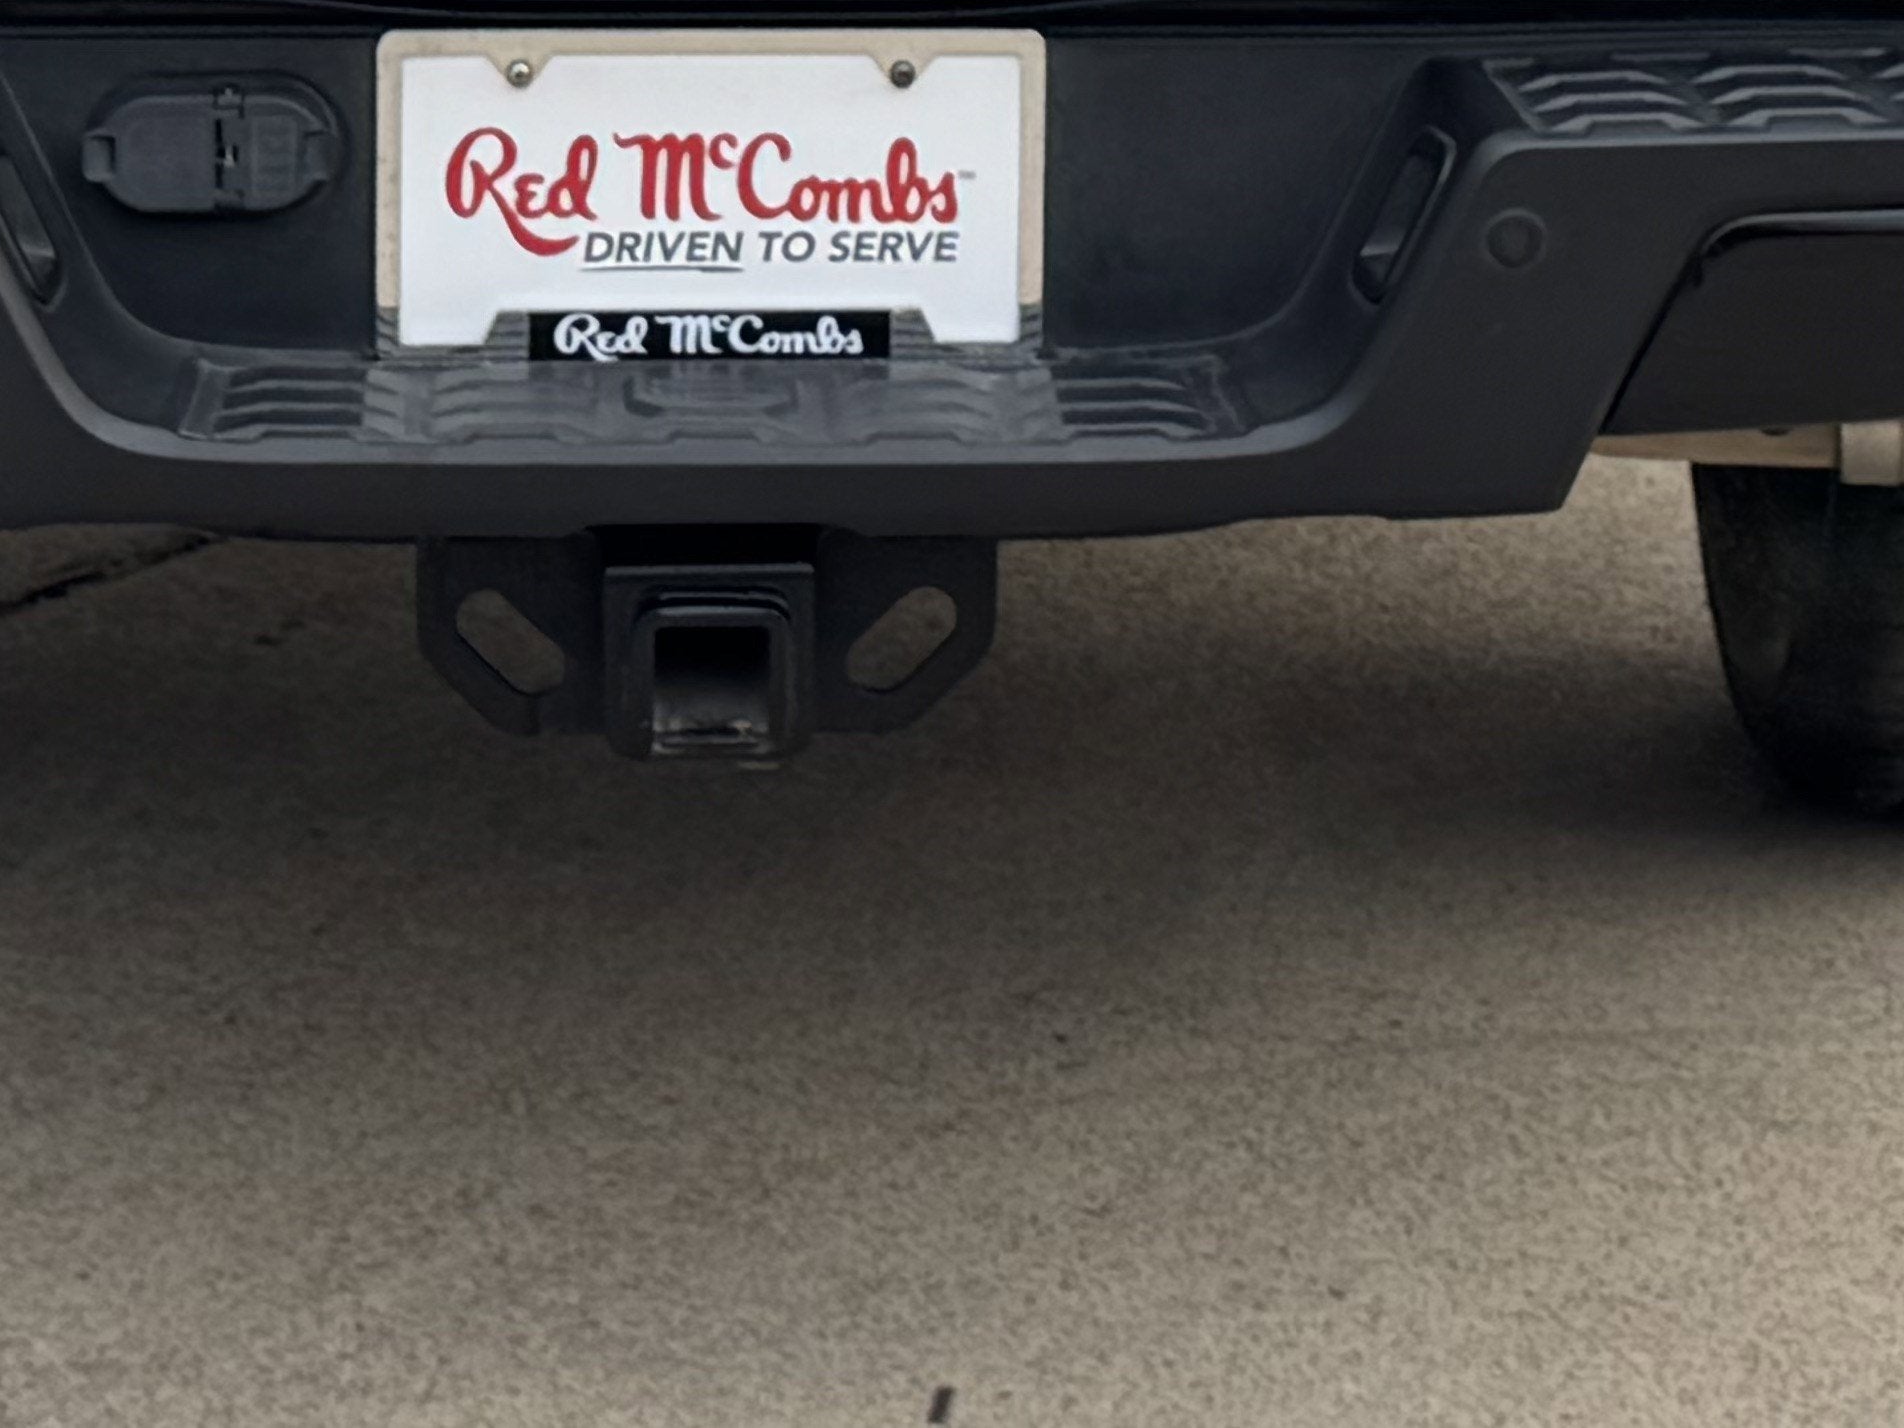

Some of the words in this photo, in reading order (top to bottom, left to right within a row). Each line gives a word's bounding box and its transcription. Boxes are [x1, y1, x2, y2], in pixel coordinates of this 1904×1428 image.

[445, 126, 598, 256] Red
[613, 131, 960, 225] McCombs
[582, 230, 744, 263] DRIVEN
[759, 230, 815, 263] TO
[829, 230, 960, 263] SERVE
[553, 312, 649, 363] Red
[654, 313, 864, 355] McCombs
